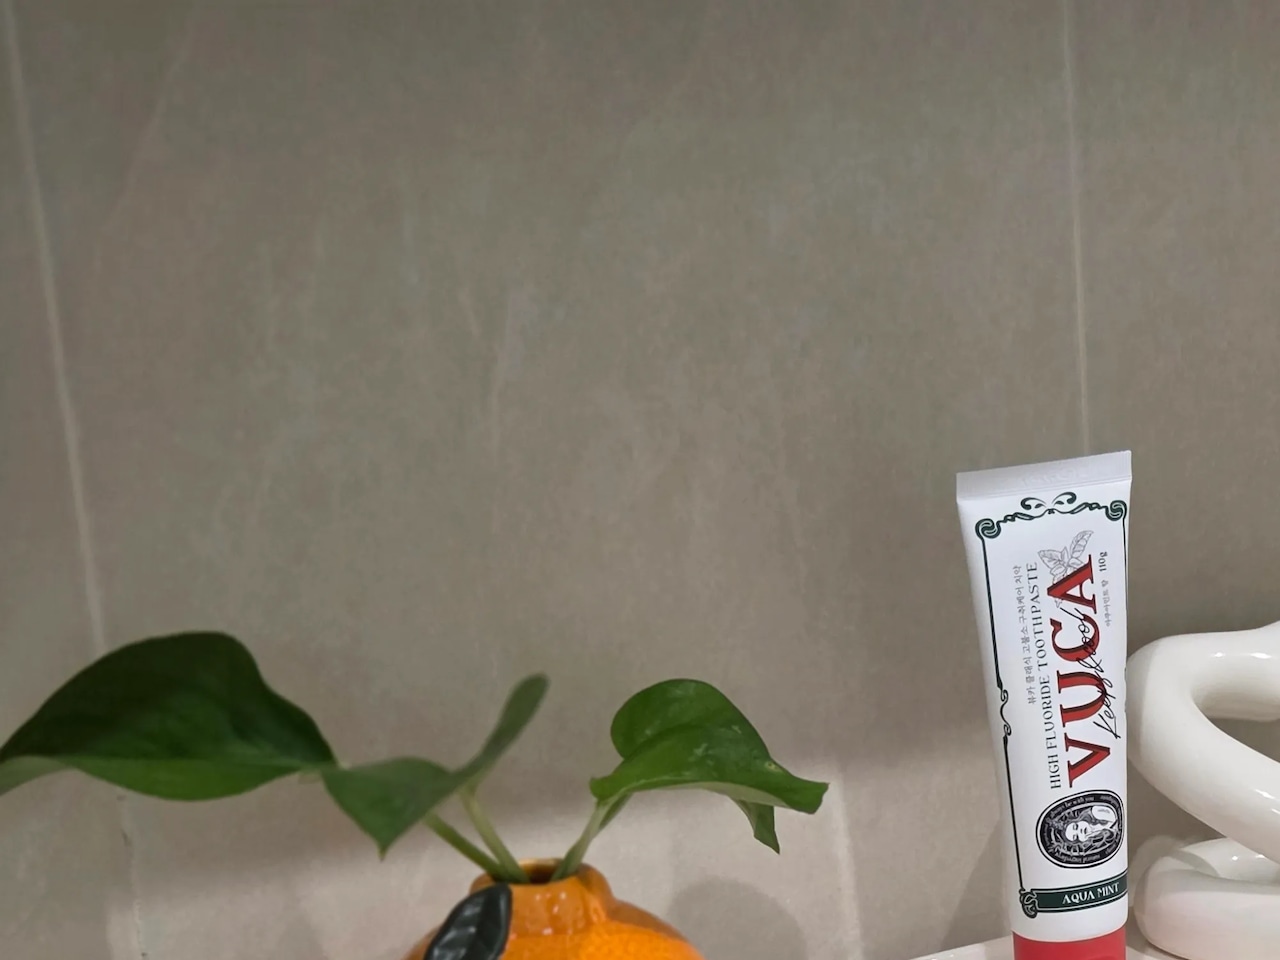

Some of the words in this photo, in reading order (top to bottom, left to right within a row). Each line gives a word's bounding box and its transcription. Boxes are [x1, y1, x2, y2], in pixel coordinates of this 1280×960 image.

[1013, 565, 1023, 585] 치약
[1098, 551, 1108, 572] 110g
[1026, 562, 1048, 671] TOOTHPASTE
[1047, 554, 1111, 788] VUCA
[1039, 675, 1058, 750] FLUORIDE
[1047, 754, 1062, 789] HIGH
[1062, 890, 1095, 904] AQUA
[1097, 882, 1119, 898] MINT
